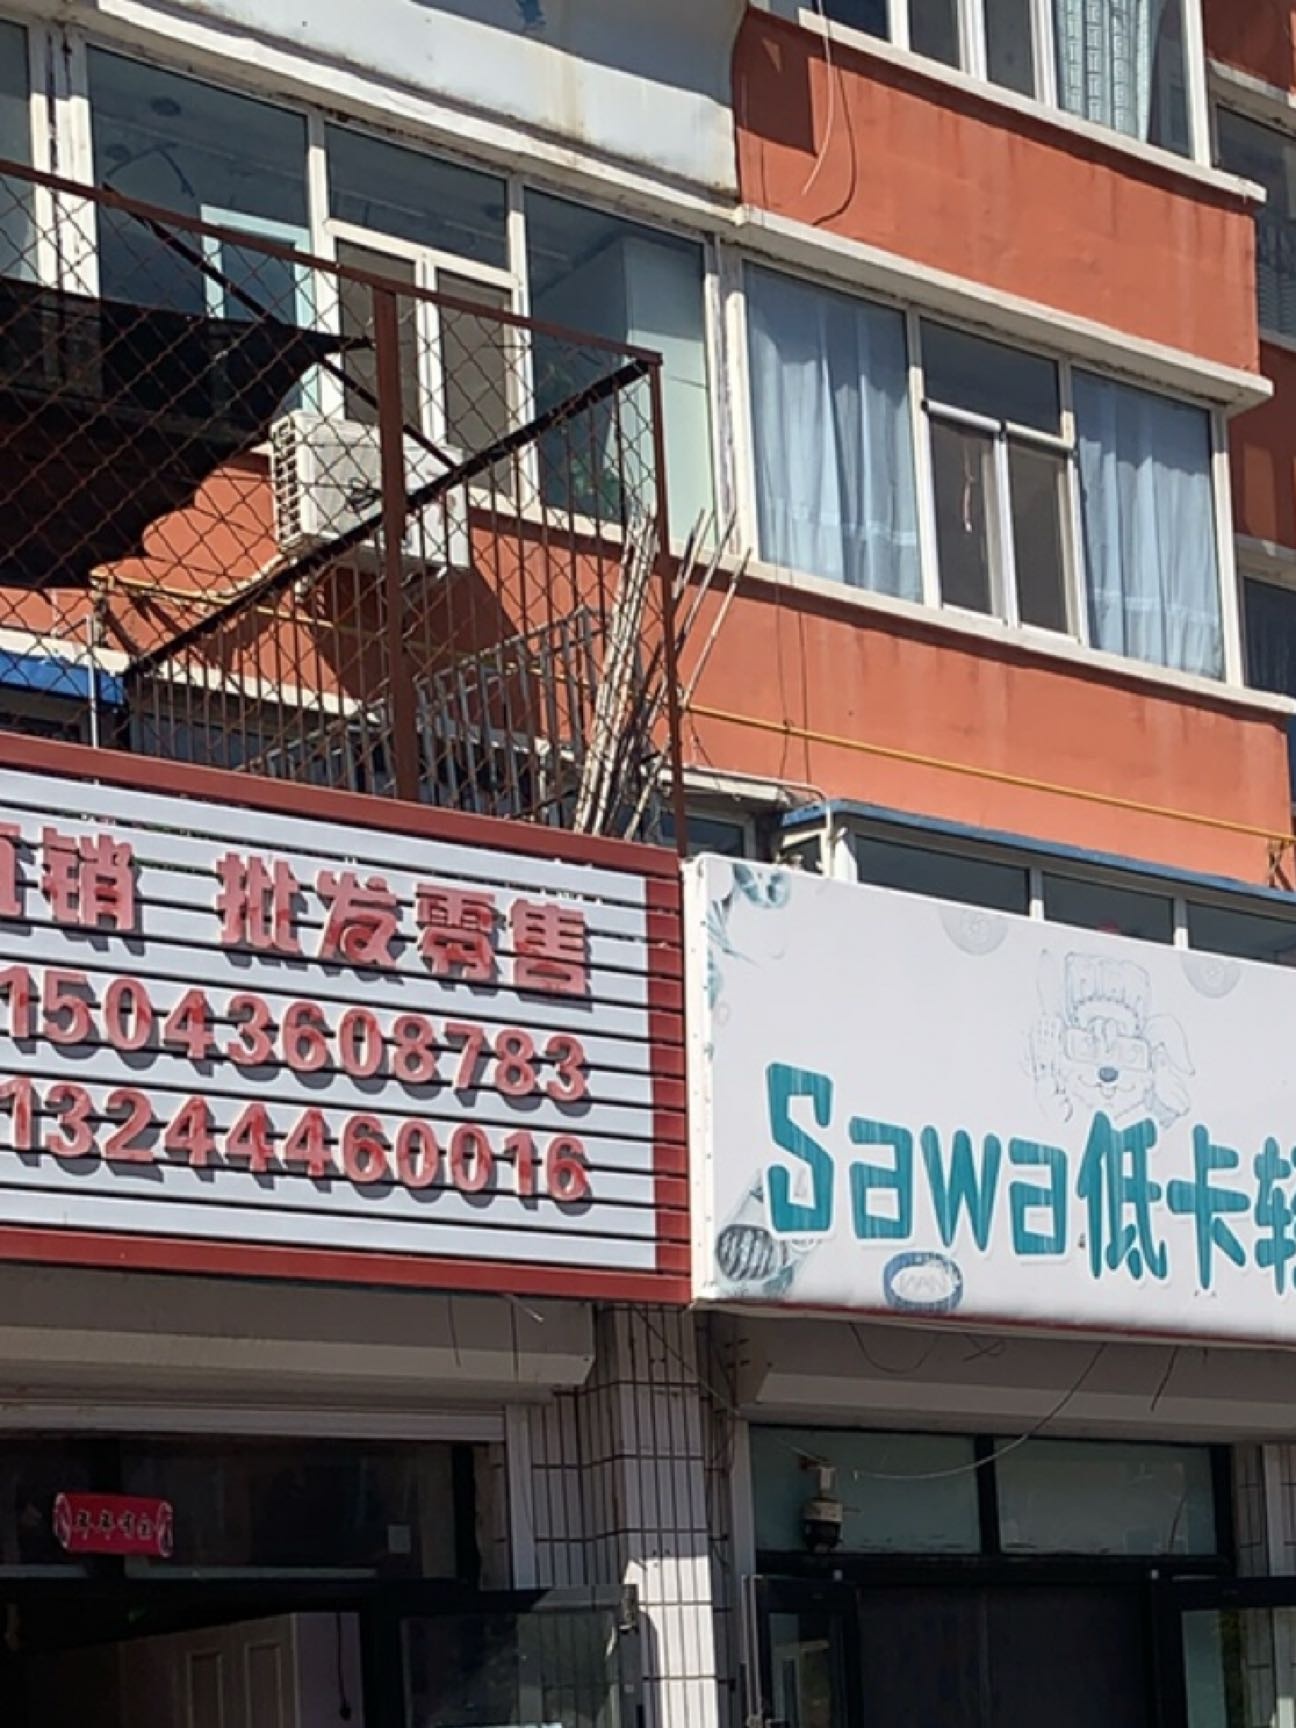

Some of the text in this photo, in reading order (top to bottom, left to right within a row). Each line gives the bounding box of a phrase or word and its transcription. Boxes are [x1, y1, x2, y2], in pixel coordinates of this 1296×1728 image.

[0, 824, 590, 995] 销 批发零售
[0, 964, 590, 1101] 15043608783
[0, 1077, 590, 1201] 13244460016
